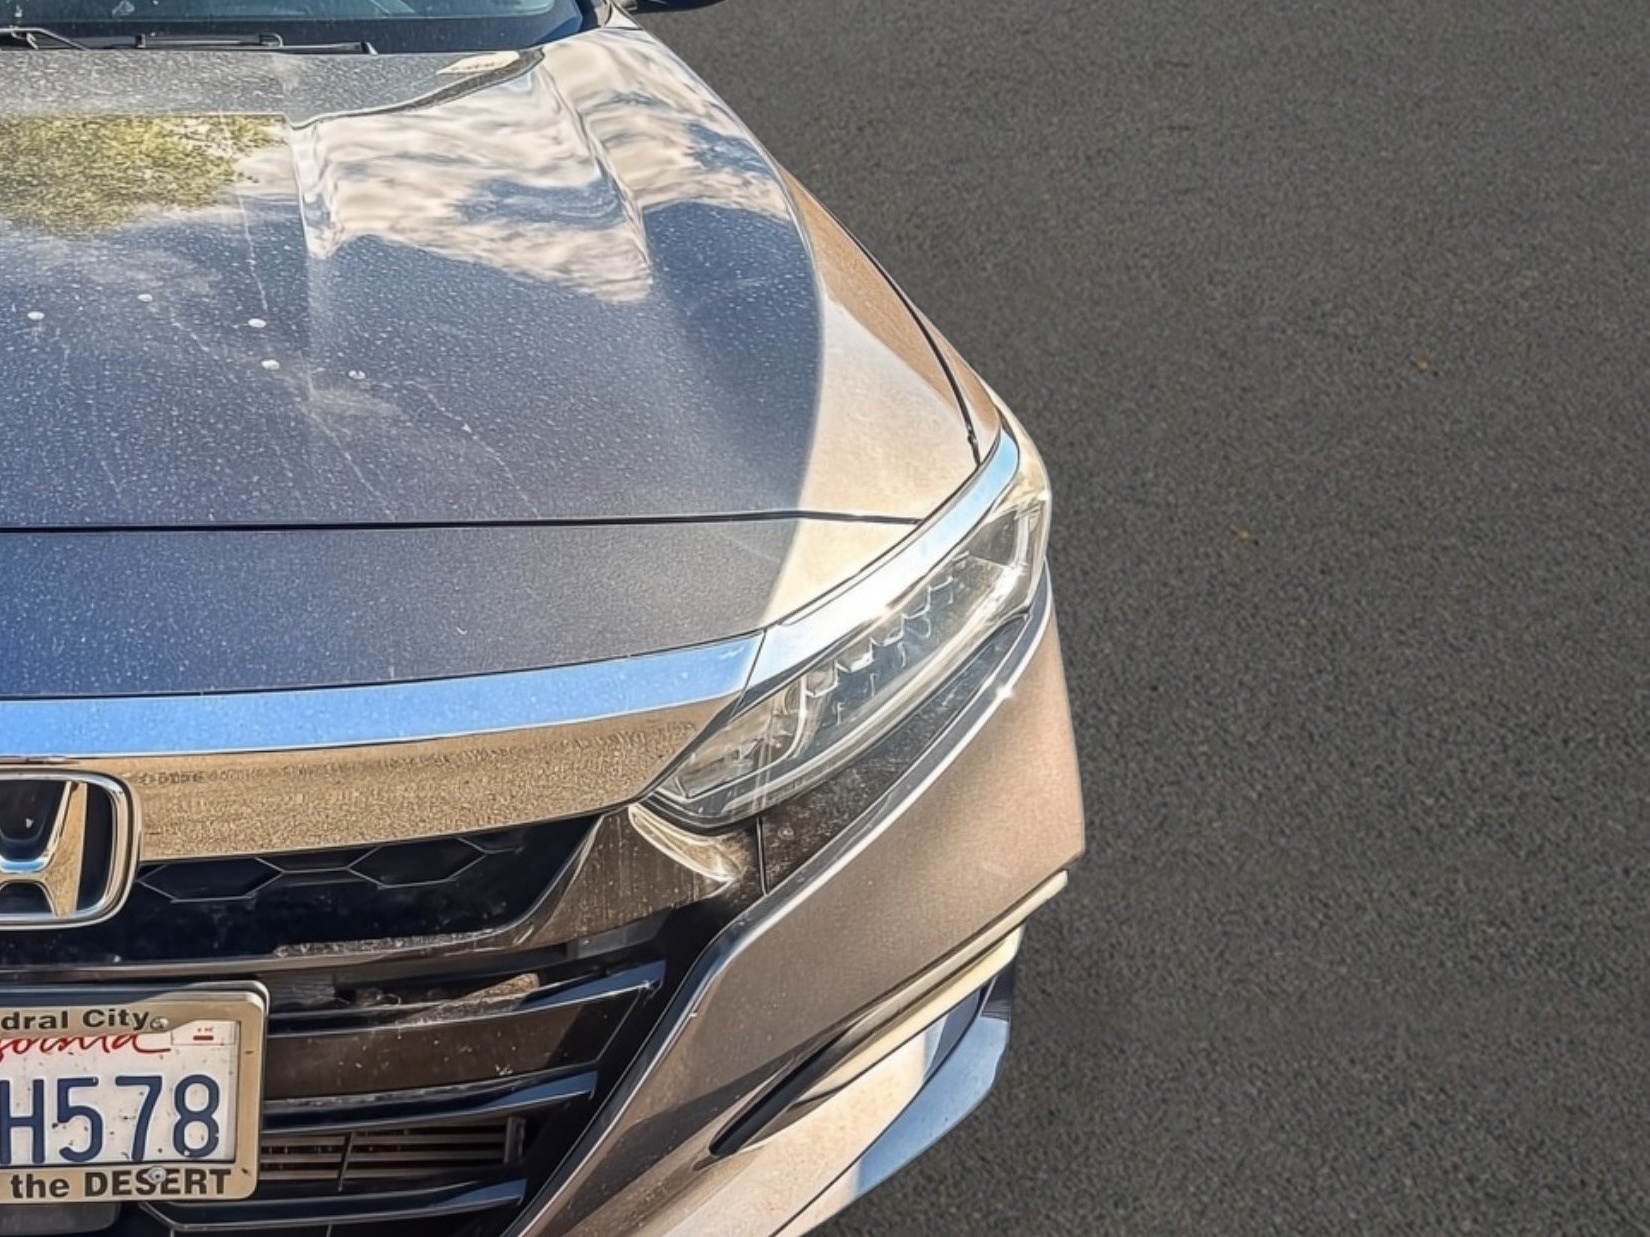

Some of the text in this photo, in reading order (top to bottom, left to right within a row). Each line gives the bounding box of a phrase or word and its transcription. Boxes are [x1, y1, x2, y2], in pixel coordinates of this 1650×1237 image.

[82, 1008, 150, 1031] City
[10, 1173, 70, 1199] the
[83, 1168, 232, 1197] DESERT
